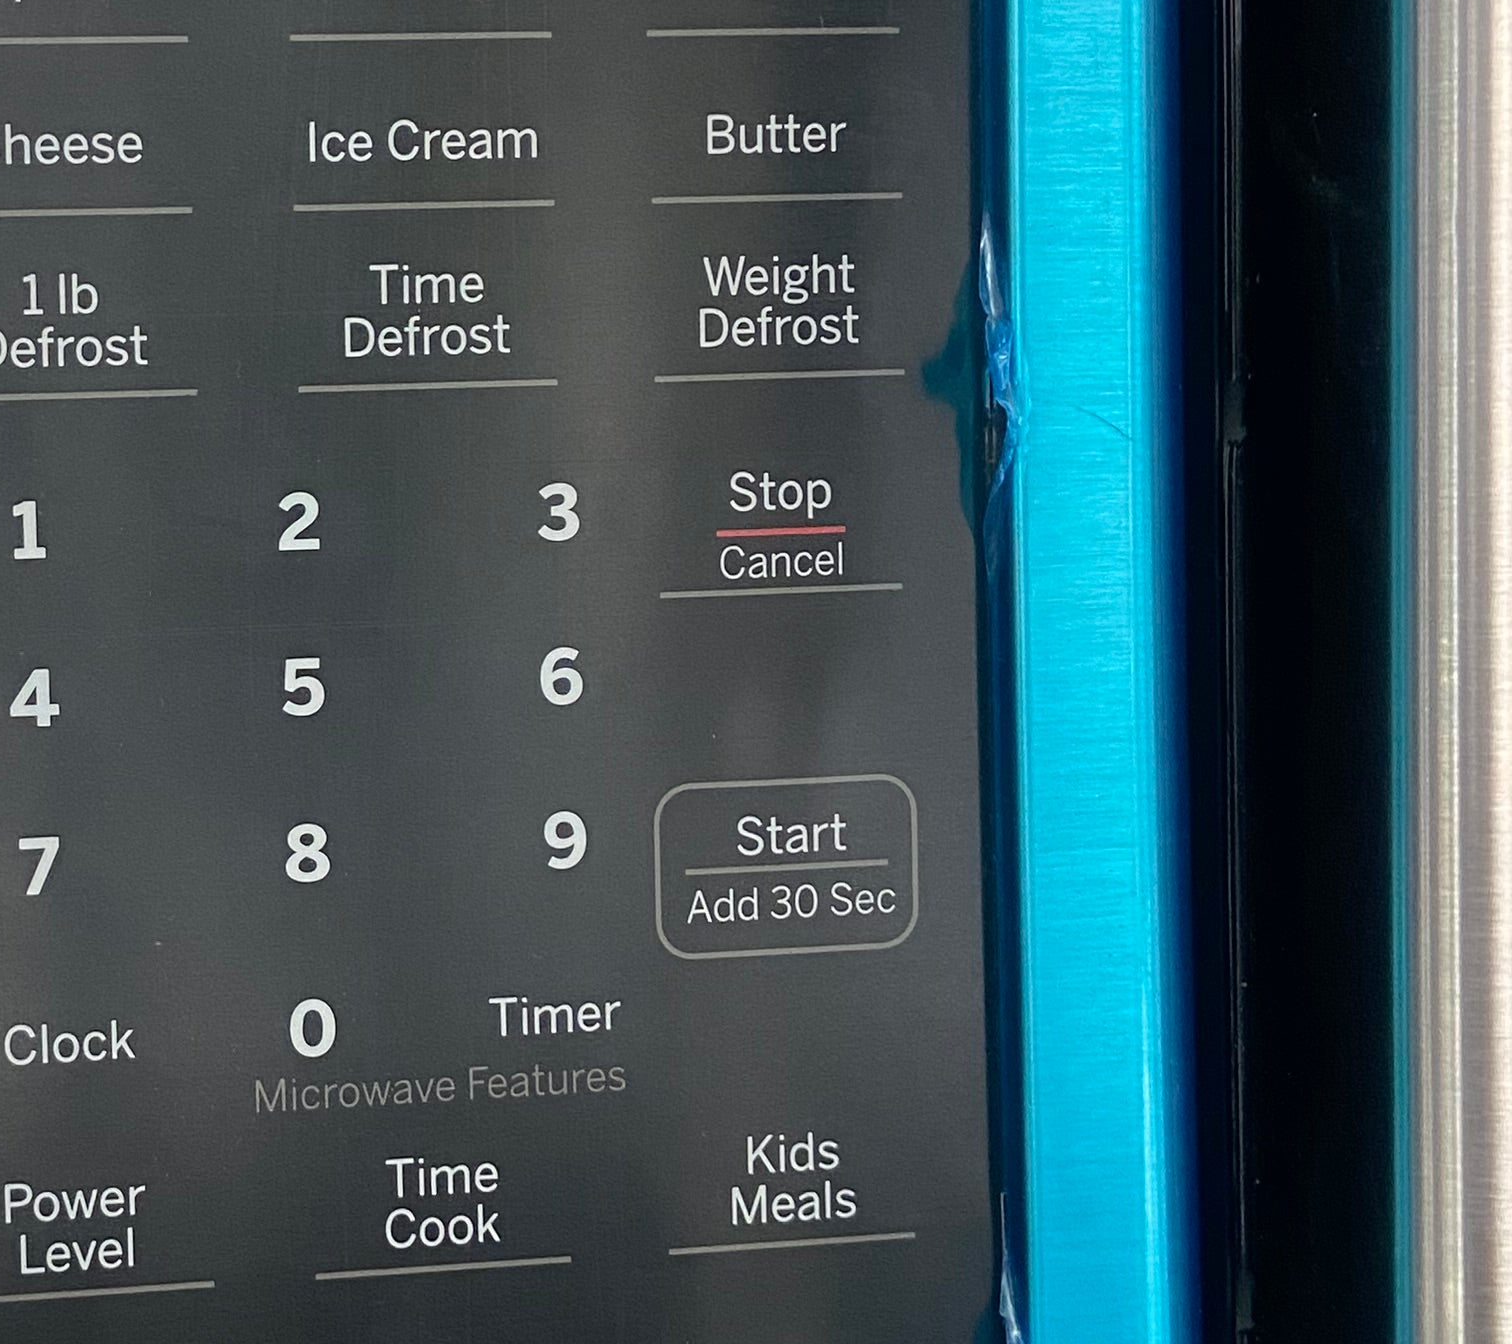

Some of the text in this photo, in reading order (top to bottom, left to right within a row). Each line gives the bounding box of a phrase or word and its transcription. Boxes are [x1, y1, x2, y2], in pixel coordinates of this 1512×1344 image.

[308, 119, 538, 163] Ice Cream
[706, 113, 847, 155] Butter
[22, 273, 99, 316] 1 lb
[368, 263, 484, 305] Time
[702, 253, 855, 305] Weight
[344, 315, 511, 358] Defrost
[699, 304, 860, 348] Defrost
[537, 482, 580, 542] 3
[729, 471, 832, 520] Stop
[12, 500, 47, 560] 1
[278, 491, 321, 551] 2
[719, 541, 843, 580] Cancel
[9, 668, 60, 727] 4
[282, 657, 325, 717] 5
[539, 646, 584, 706] 6
[285, 823, 331, 883] 8
[543, 810, 587, 870] 9
[737, 813, 847, 857] Start
[18, 836, 60, 896] 7
[687, 882, 896, 924] Add 30 Sec
[289, 998, 336, 1058] 0
[488, 996, 622, 1037] Timer
[4, 1019, 136, 1066] Clock
[255, 1063, 626, 1114] Microwave Features
[747, 1131, 840, 1175] Kids
[384, 1157, 499, 1199] Time
[4, 1183, 146, 1224] Power
[385, 1203, 501, 1249] Cook
[731, 1180, 857, 1226] Meals
[19, 1226, 135, 1275] Level
